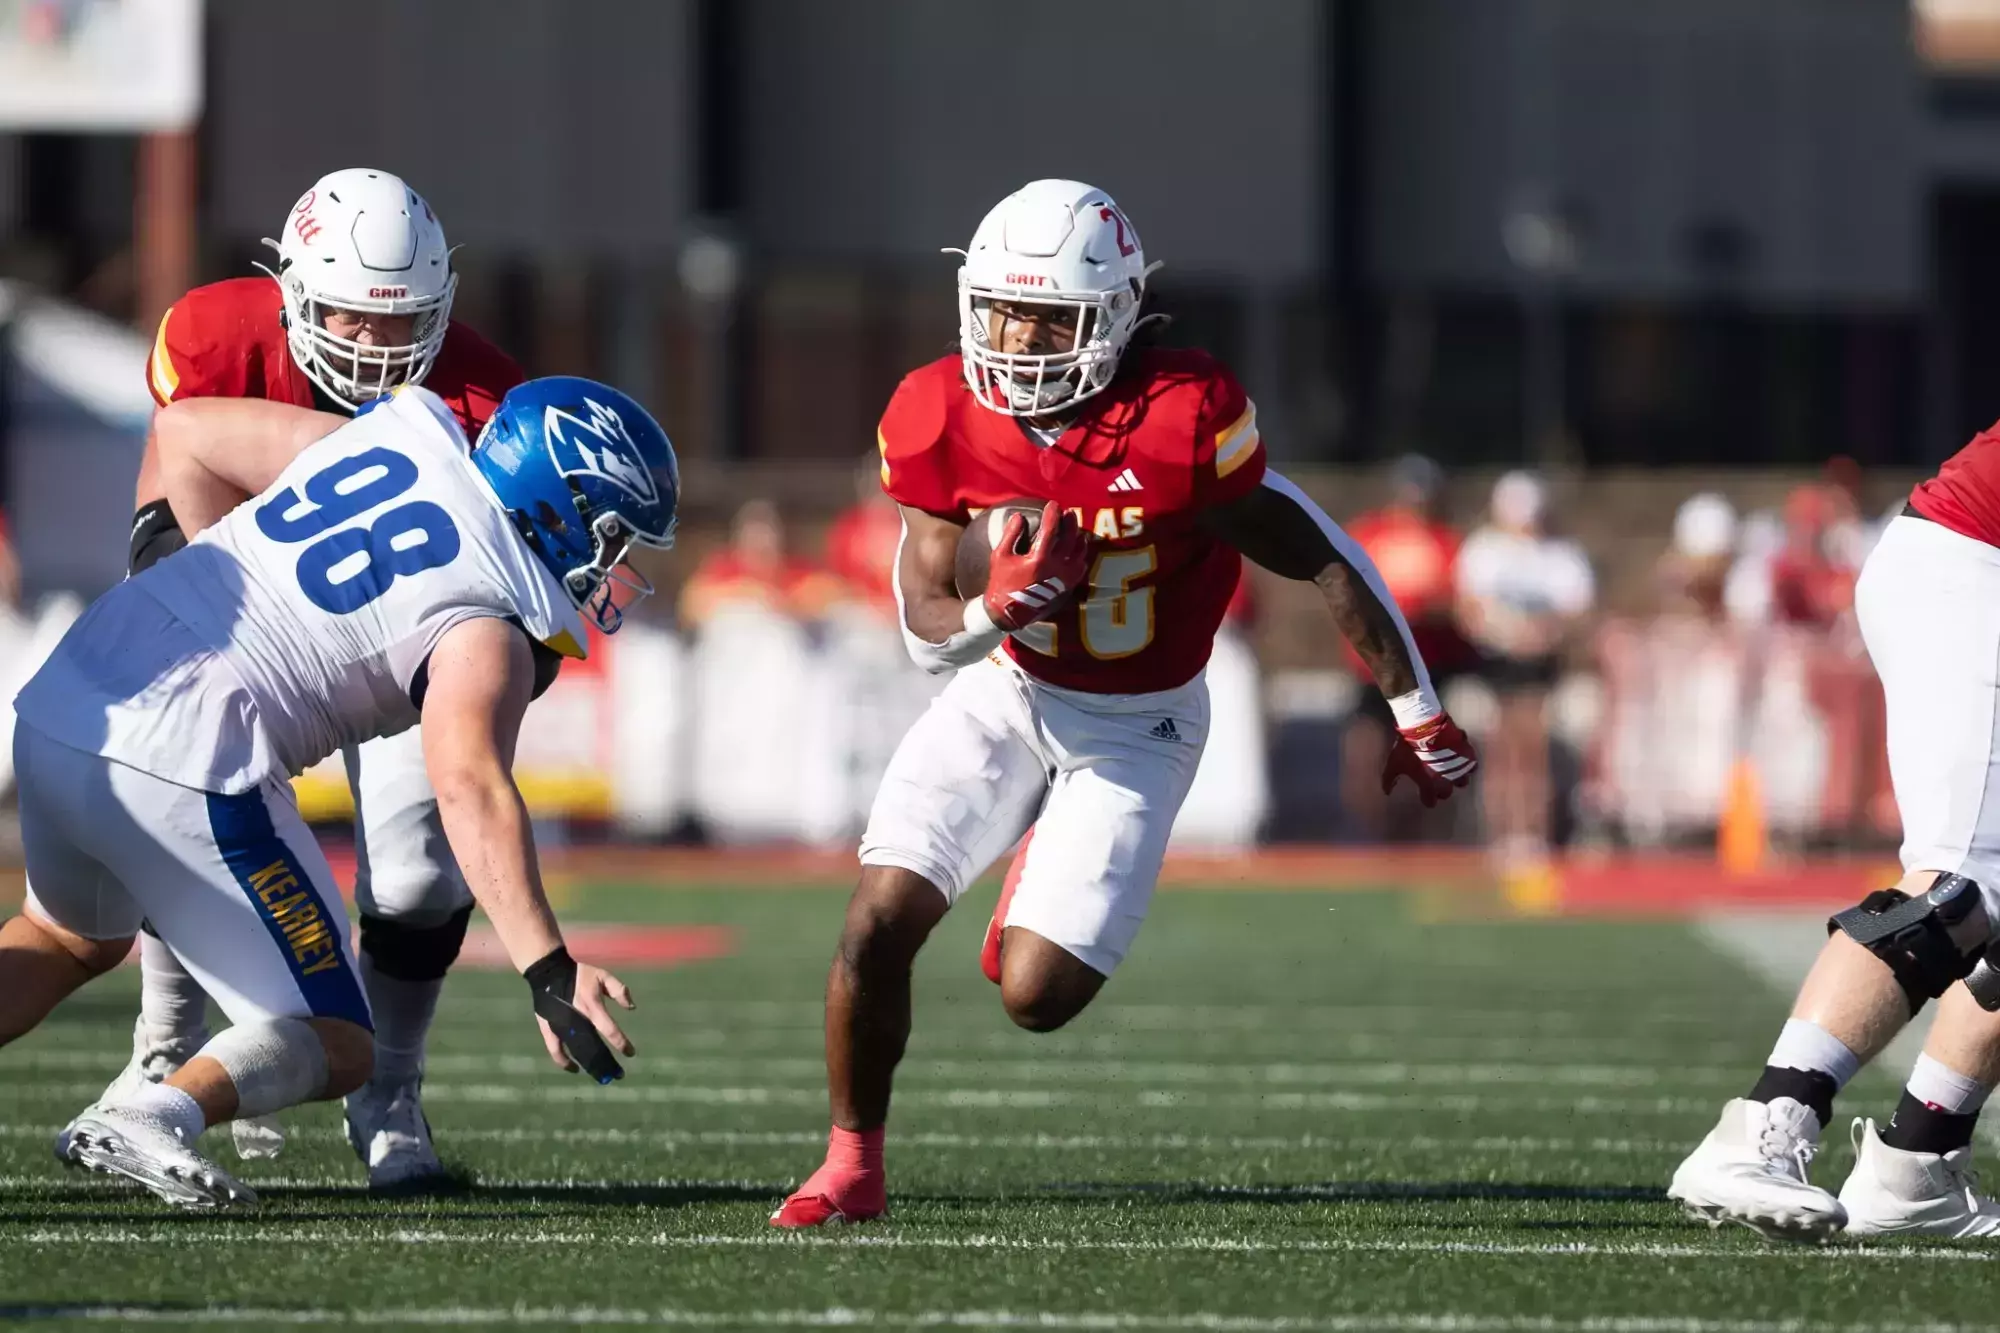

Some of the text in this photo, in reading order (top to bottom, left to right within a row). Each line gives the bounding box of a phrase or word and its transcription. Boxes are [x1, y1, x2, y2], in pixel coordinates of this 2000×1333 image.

[291, 190, 322, 246] Pitt
[1099, 206, 1141, 258] 2
[369, 287, 408, 298] GRIT
[1006, 272, 1047, 287] GRIT
[254, 446, 460, 615] 98
[247, 859, 339, 976] KEARNEY
